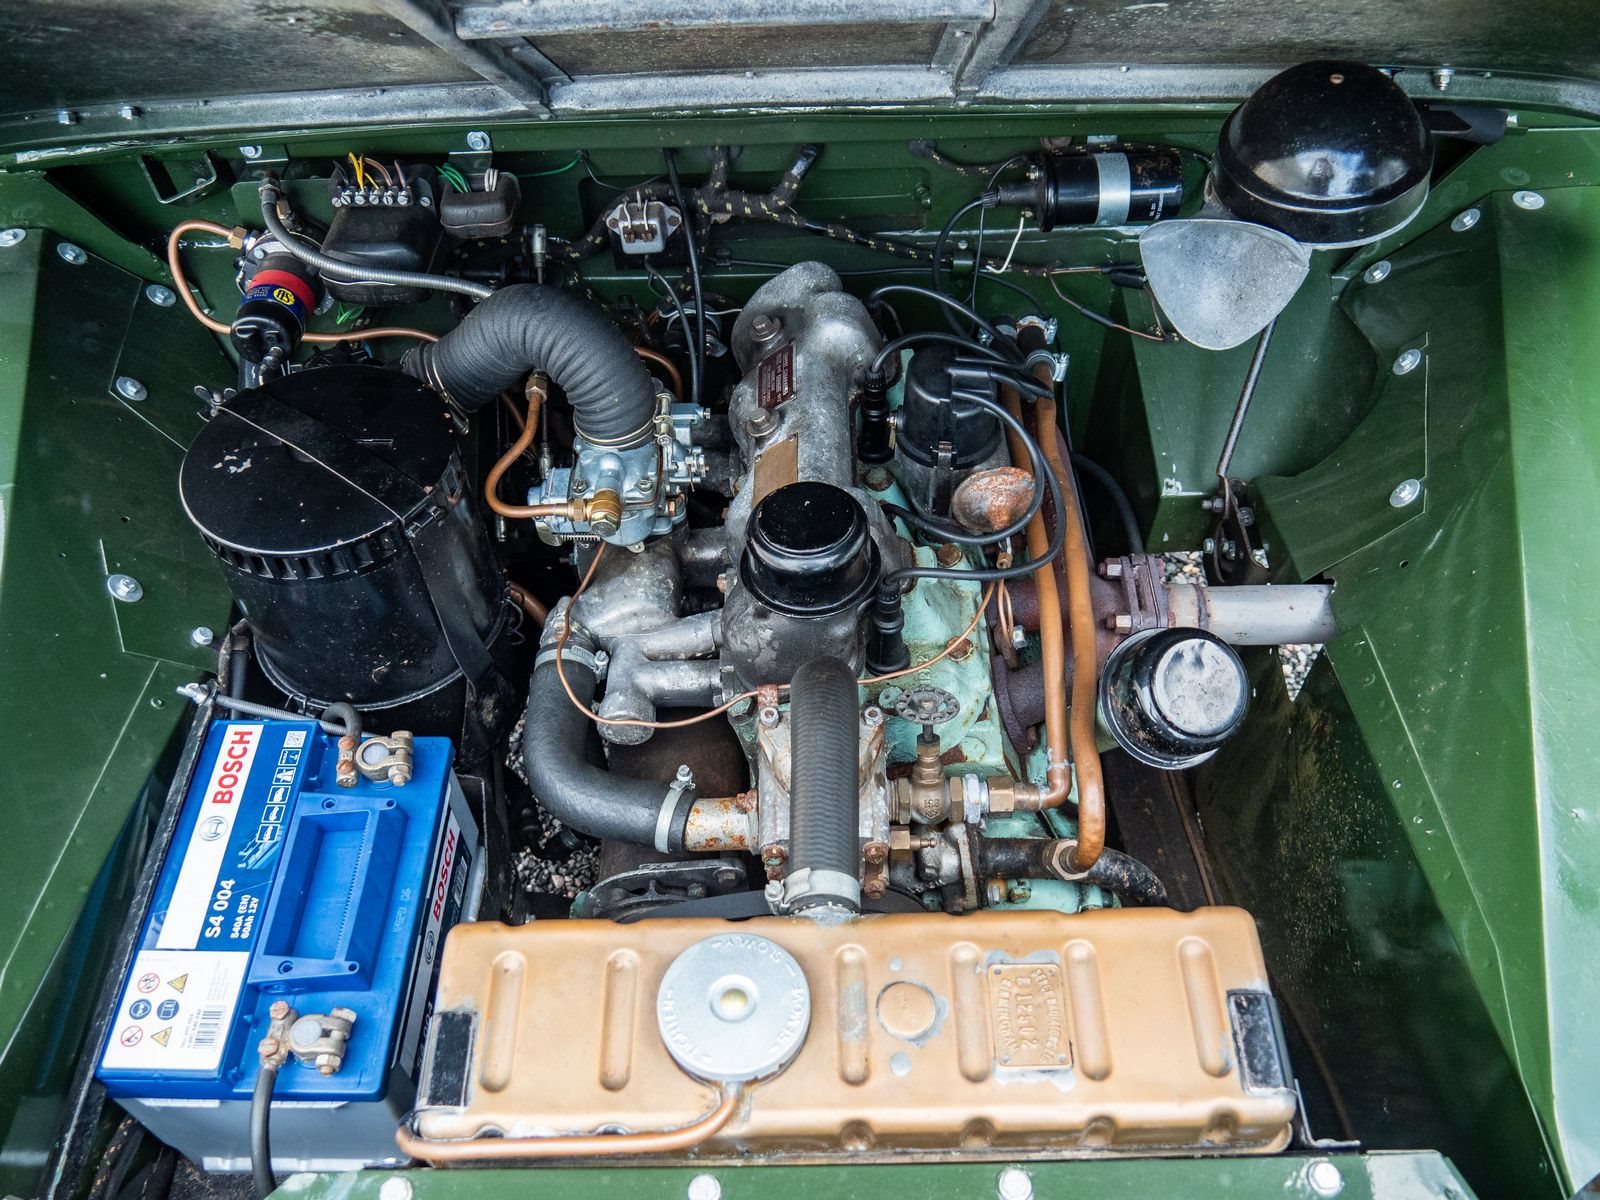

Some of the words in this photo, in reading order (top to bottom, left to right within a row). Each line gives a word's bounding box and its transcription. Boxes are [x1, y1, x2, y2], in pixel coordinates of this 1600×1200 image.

[277, 289, 291, 303] SU
[212, 731, 253, 804] BOSCH
[433, 828, 455, 922] BOSCH
[213, 879, 236, 911] 004
[237, 894, 251, 914] (EN)
[204, 915, 225, 938] S4
[230, 915, 245, 939] 540A
[240, 916, 255, 939] 60Ah
[248, 897, 259, 913] 12V
[724, 935, 784, 964] SLOWLY
[778, 983, 804, 1045] REMOVE
